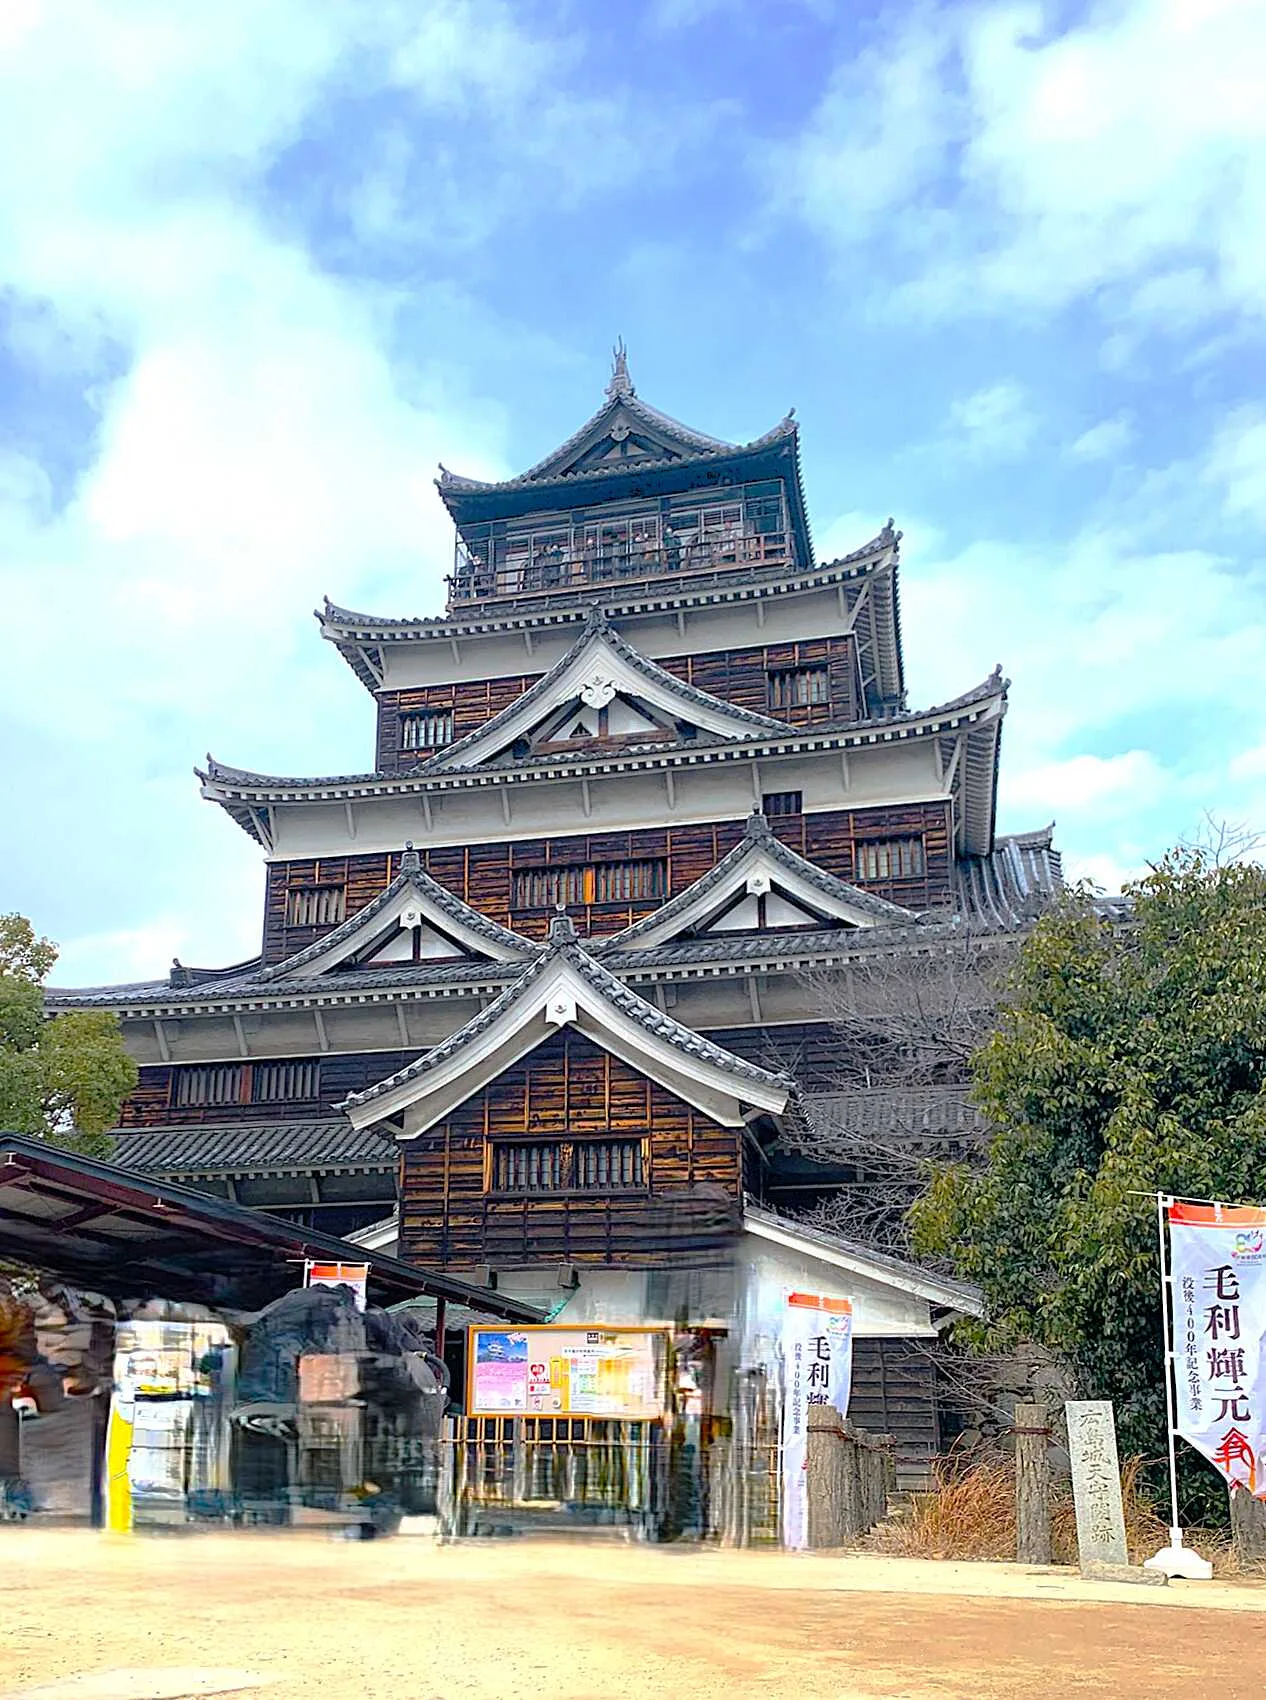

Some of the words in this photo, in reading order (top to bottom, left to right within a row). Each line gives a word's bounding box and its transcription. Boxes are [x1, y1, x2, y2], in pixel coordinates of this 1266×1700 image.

[1202, 1265, 1252, 1423] 毛利輝元
[1080, 1408, 1115, 1545] 広島城天守閣跡
